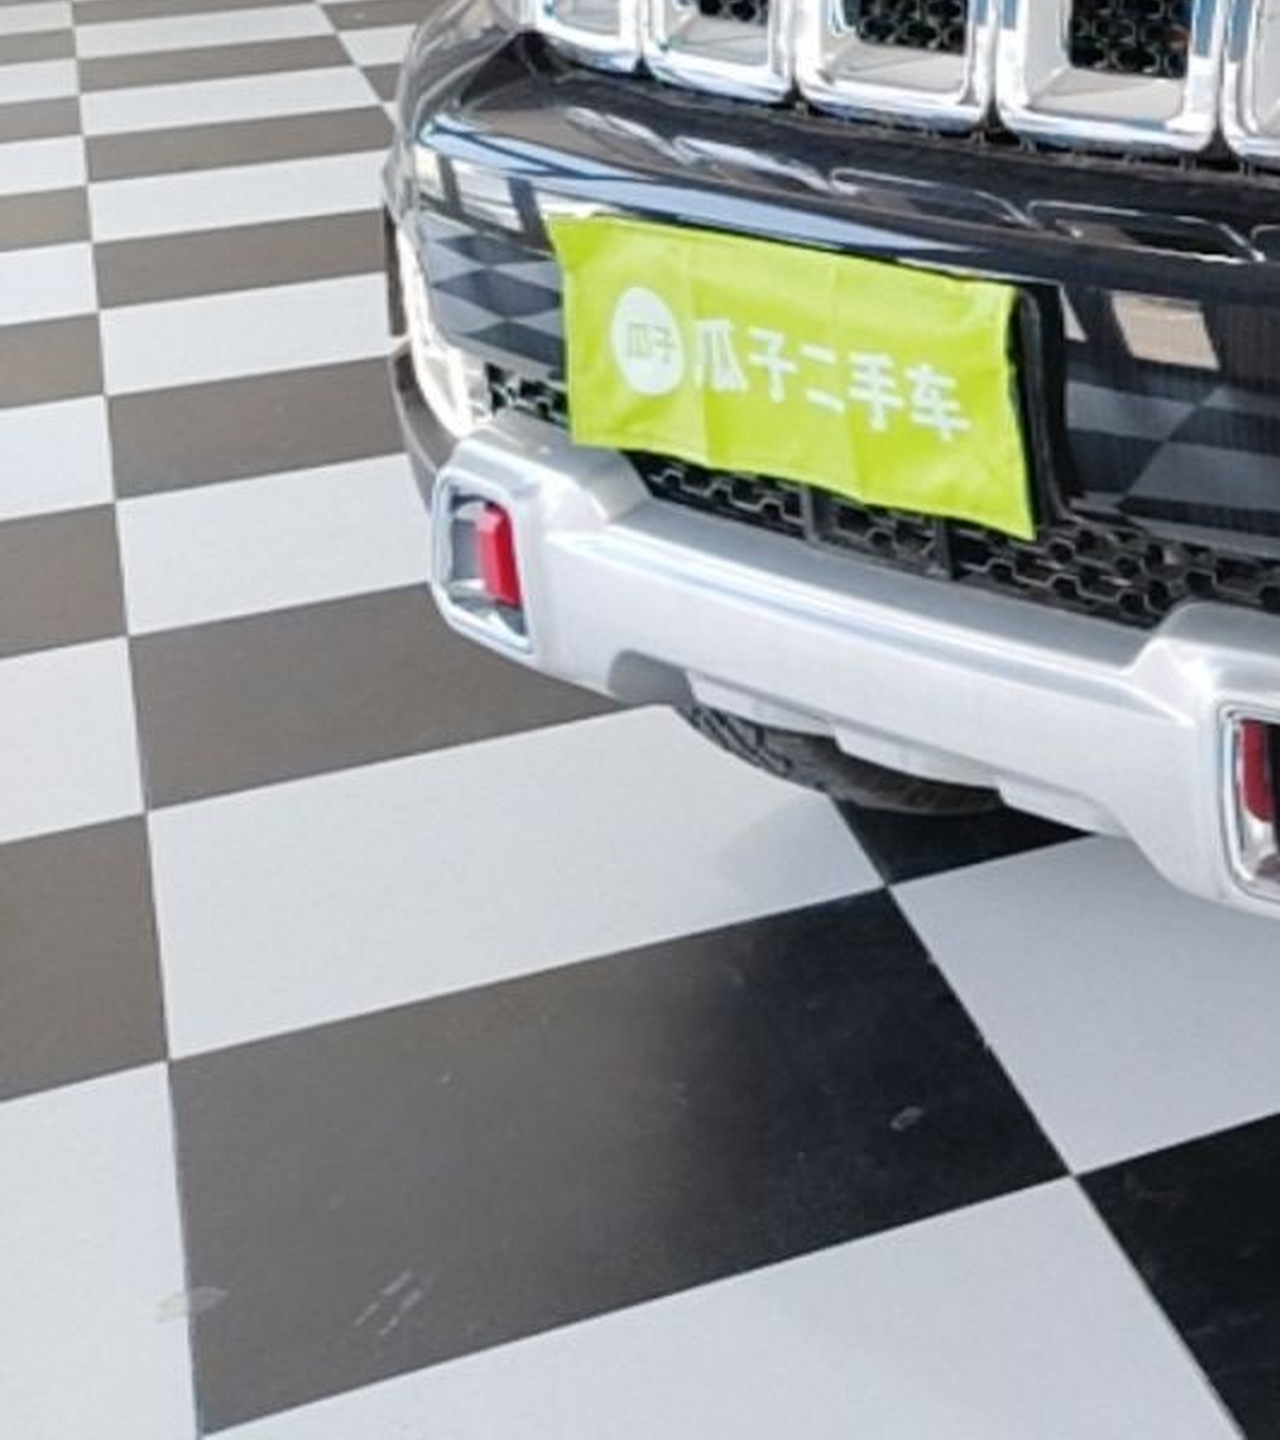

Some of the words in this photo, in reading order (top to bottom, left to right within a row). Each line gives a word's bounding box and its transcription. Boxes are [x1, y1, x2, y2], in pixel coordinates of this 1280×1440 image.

[625, 322, 676, 365] 瓜子
[692, 317, 971, 442] 瓜子二手车
